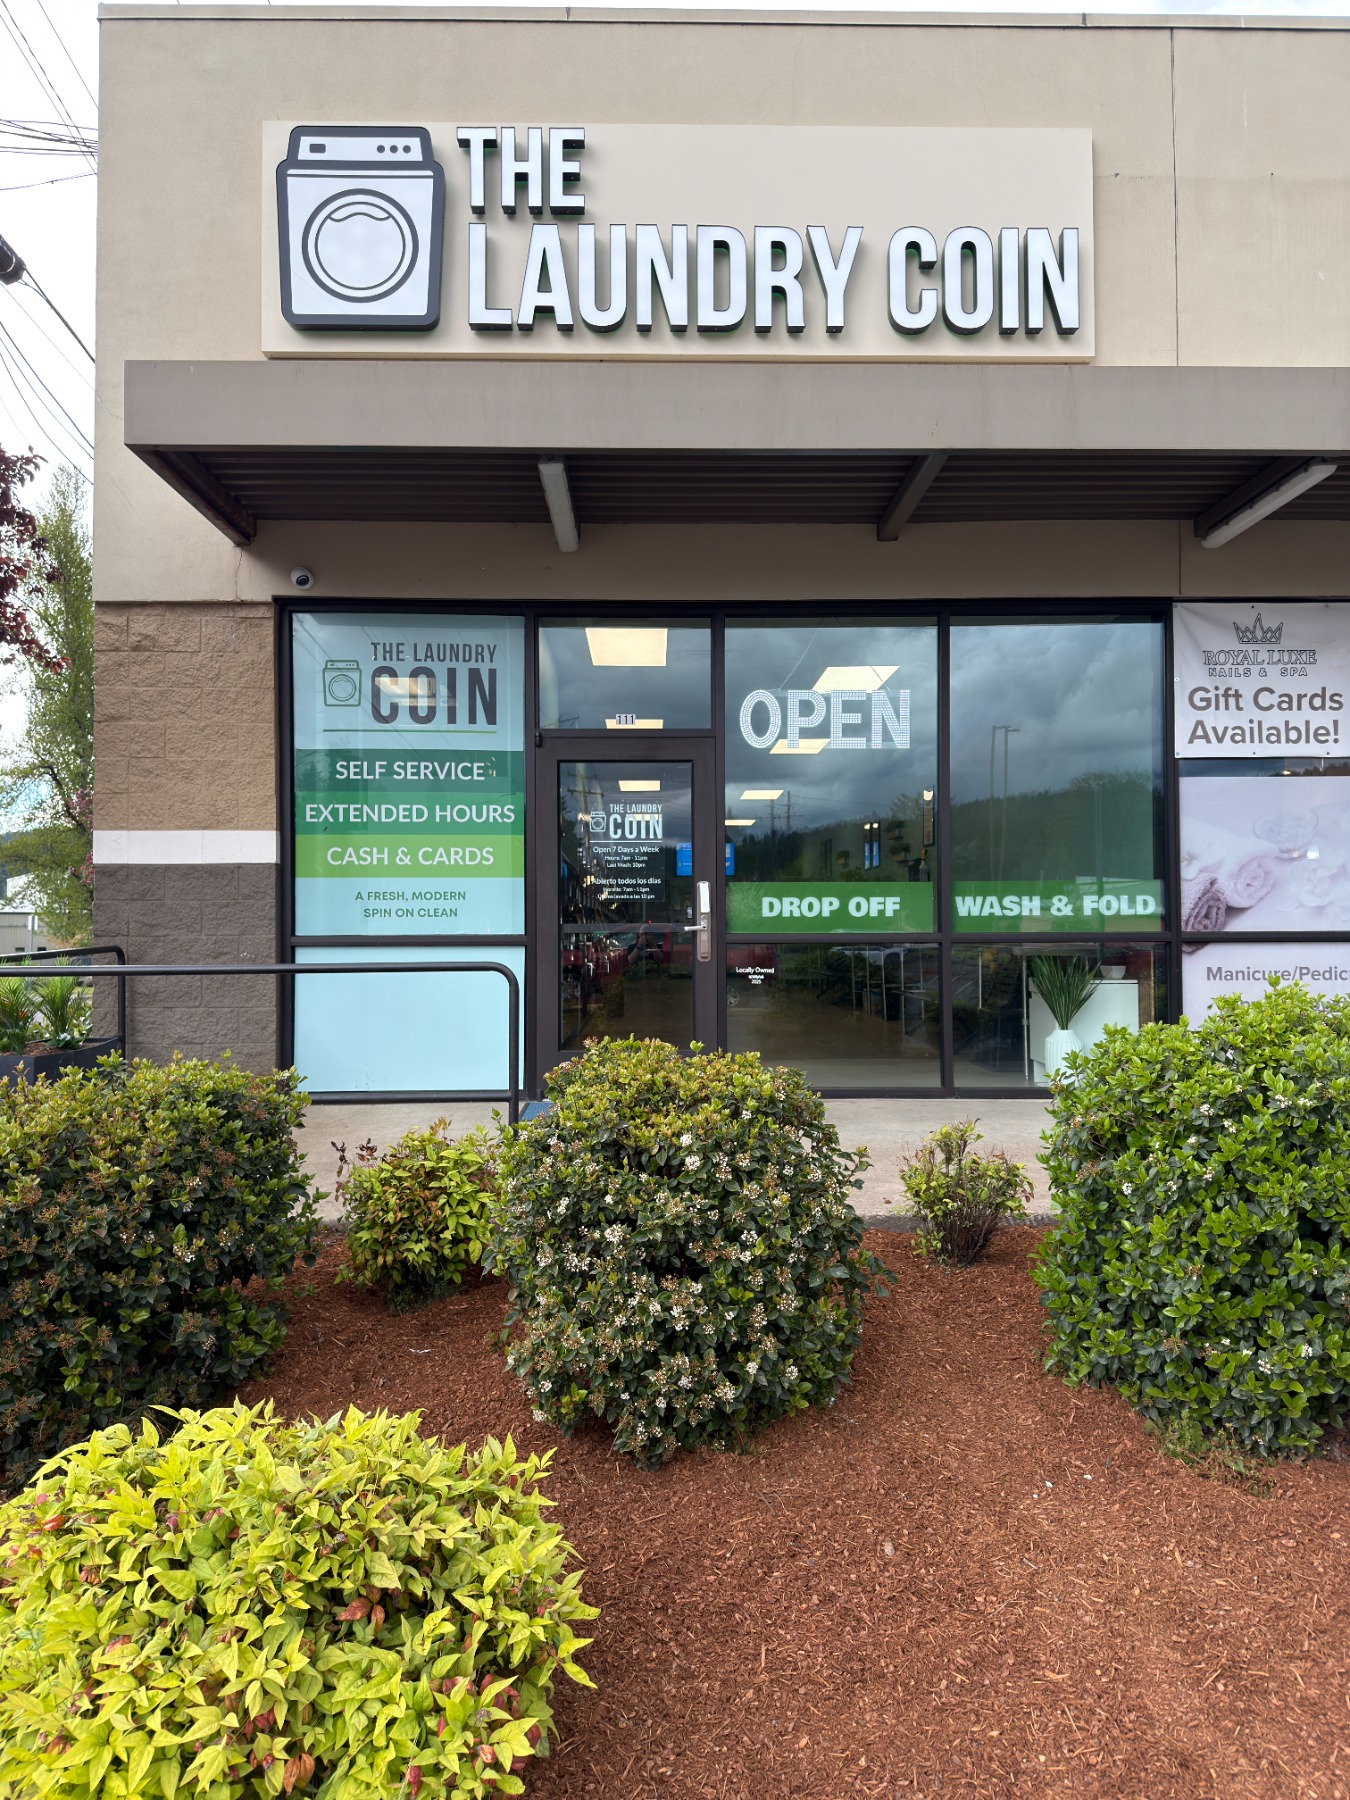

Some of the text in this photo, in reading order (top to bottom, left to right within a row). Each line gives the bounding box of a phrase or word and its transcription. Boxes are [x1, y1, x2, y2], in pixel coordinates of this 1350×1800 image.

[457, 126, 586, 215] THE
[468, 223, 1080, 336] LAUNDRY COIN
[371, 642, 497, 663] THE LAUNDRY
[1203, 650, 1317, 665] ROYAL LUXE
[1208, 667, 1308, 677] NAILS & SPA
[371, 666, 497, 725] COIN
[1188, 686, 1344, 712] Gift Cards
[618, 714, 634, 724] 111
[739, 689, 910, 749] OPEN
[1188, 720, 1340, 745] Available!
[335, 761, 485, 780] SELF SERVICE
[305, 804, 515, 822] EXTENDED HOURS
[610, 804, 662, 813] THE LAUNDRY
[610, 814, 662, 839] COIN
[327, 847, 494, 865] CASH & CARDS
[355, 891, 466, 902] A FRESH, MODERN
[954, 895, 1156, 917] WASH & FOLD
[364, 908, 458, 918] SPIN ON CLEAN
[762, 896, 900, 918] DROP OFF
[1206, 966, 1350, 981] Manicure/Pedic
